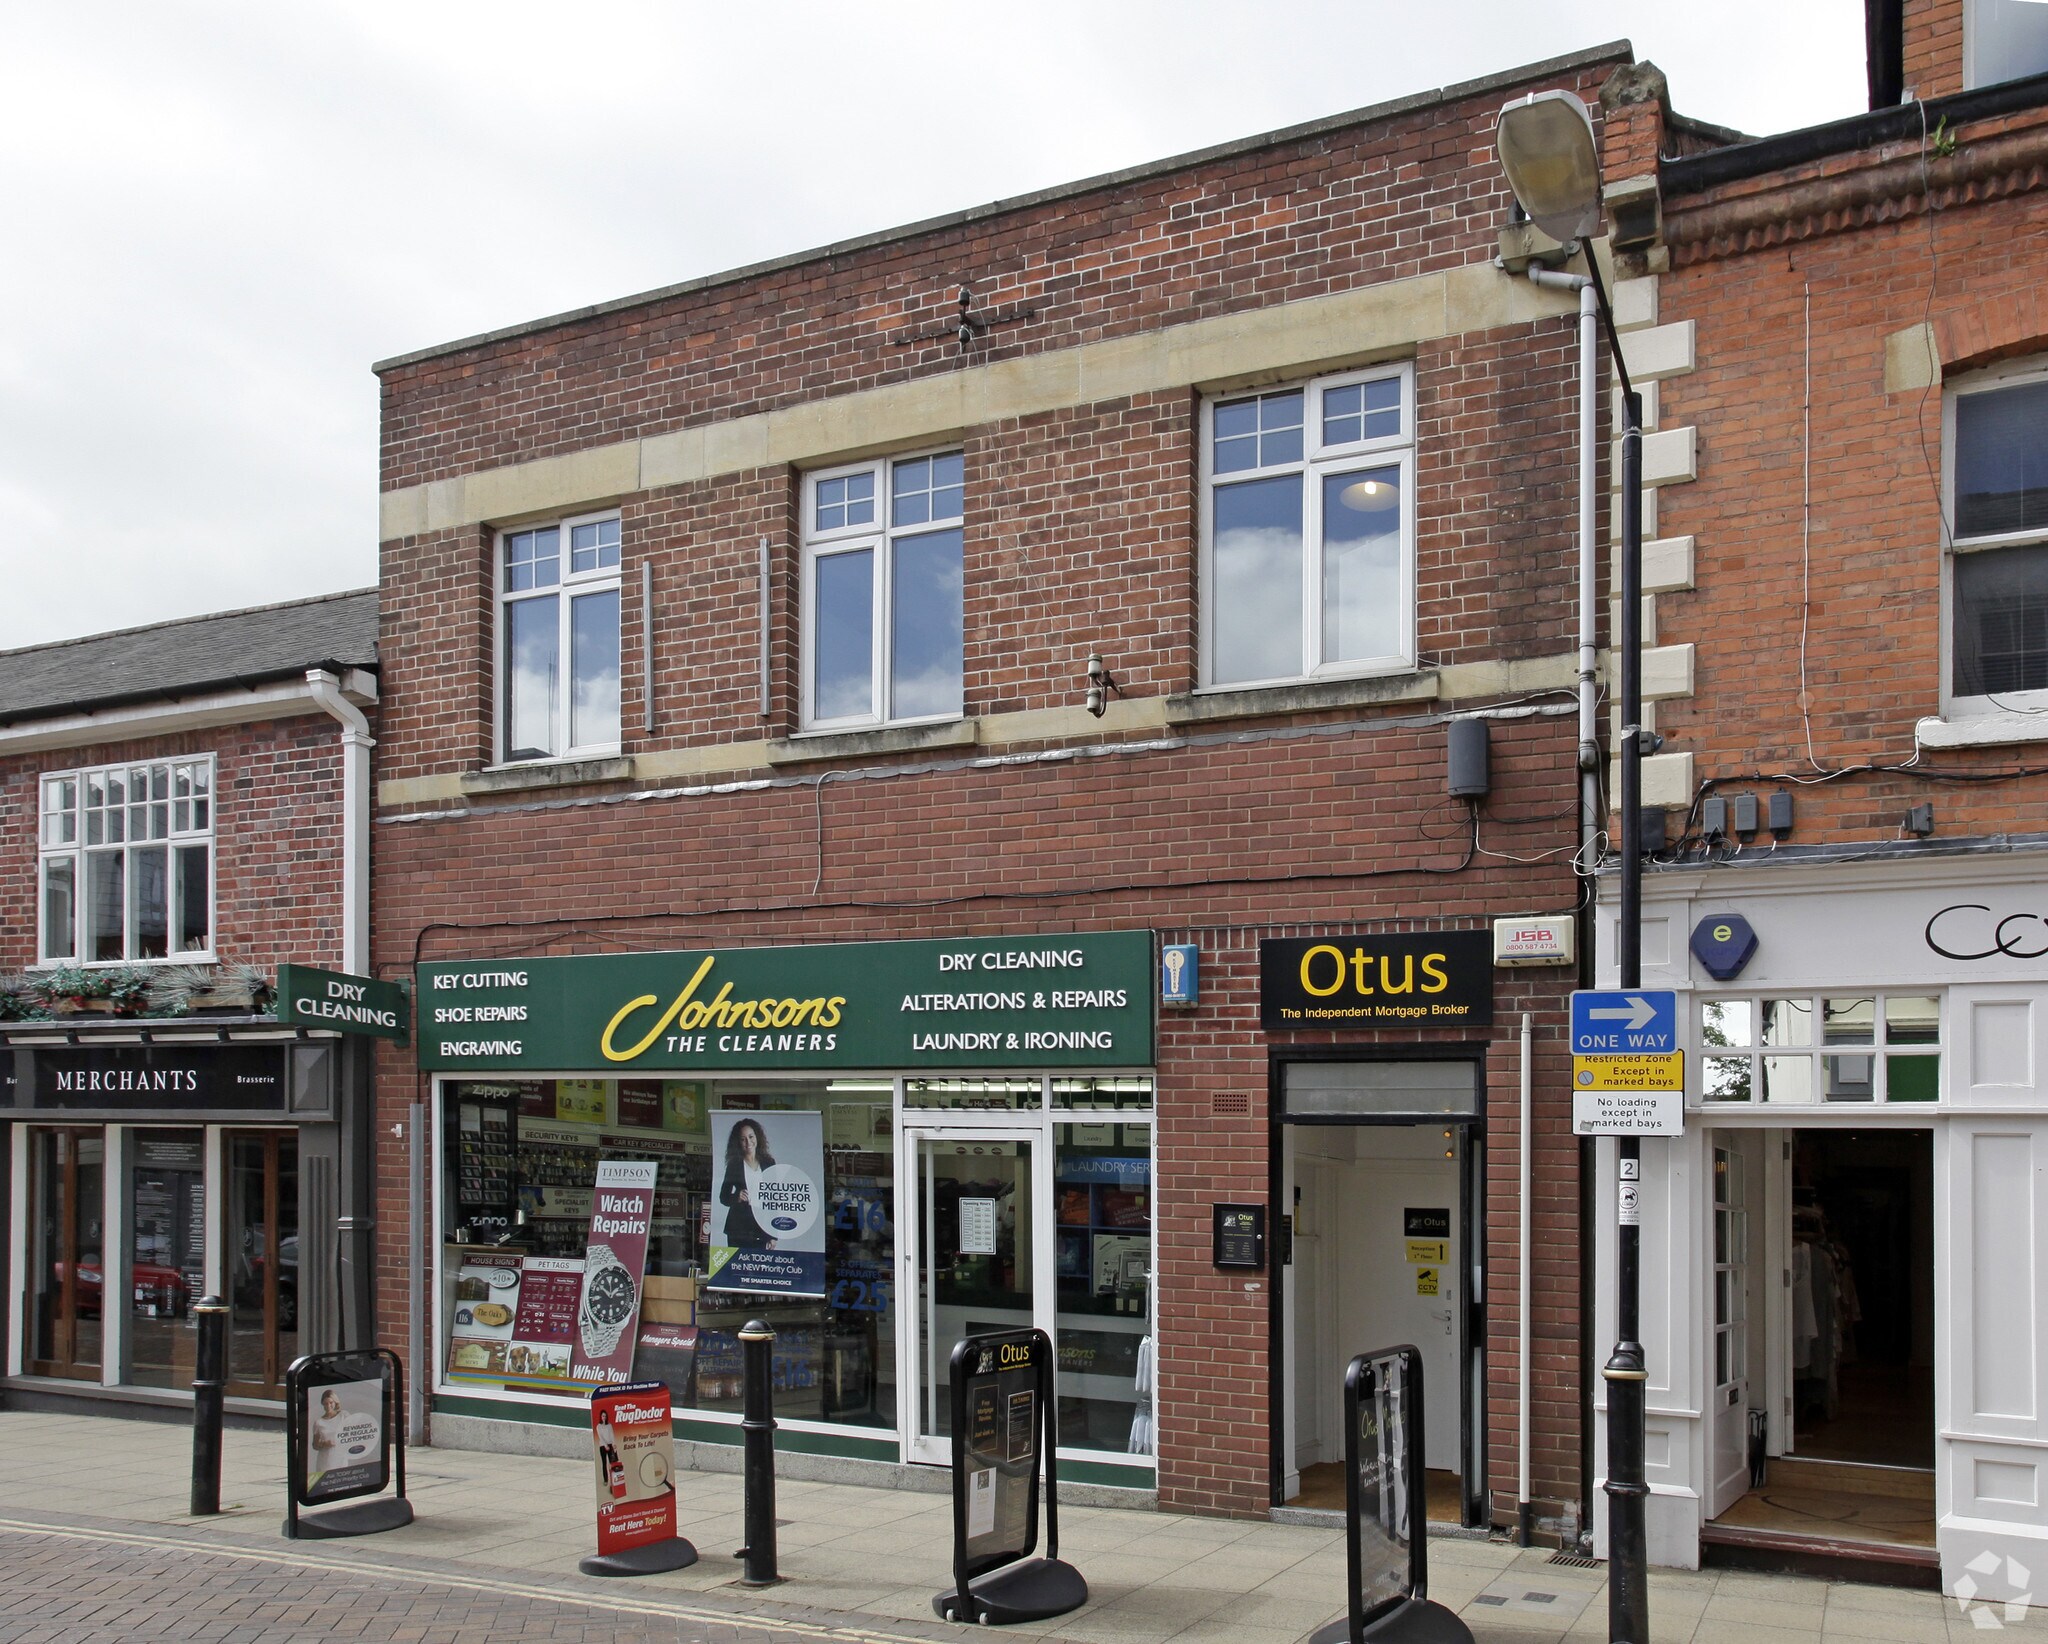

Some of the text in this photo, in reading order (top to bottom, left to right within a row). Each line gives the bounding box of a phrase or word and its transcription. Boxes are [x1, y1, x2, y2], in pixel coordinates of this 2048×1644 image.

[1511, 930, 1552, 942] JSB
[939, 950, 1083, 971] DRY CLEANING
[1300, 945, 1448, 997] Otus
[434, 972, 528, 990] KEY CUTTING
[328, 981, 366, 1002] DRY
[901, 990, 1126, 1011] ALTERATIONS & REPAIRS
[296, 998, 396, 1027] CLEANING
[435, 1006, 527, 1023] SHOE REPAIRS
[601, 956, 846, 1061] Johnsons
[1281, 1004, 1469, 1019] The Independent Mortgage Broker
[667, 1034, 837, 1052] THE CLEANERS
[913, 1031, 1112, 1050] LAUNDRY & IRONING
[1579, 1033, 1668, 1048] ONE WAY
[440, 1041, 522, 1056] ENGRAVING
[1585, 1055, 1672, 1063] Restricted Zone
[1613, 1067, 1664, 1076] Except in
[7, 1077, 18, 1085] Bar
[57, 1070, 197, 1091] MERCHANTS
[237, 1075, 274, 1084] Brasserie
[1649, 1078, 1674, 1087] bays
[1597, 1098, 1657, 1107] No loading
[1601, 1109, 1638, 1118] except
[1592, 1119, 1662, 1129] marked bays
[525, 1131, 579, 1143] SECURITY KEYS
[613, 1138, 627, 1146] CAR
[640, 1141, 674, 1150] SPECIALIST
[602, 1168, 651, 1177] TIMPSON
[1071, 1161, 1151, 1174] LAUNDRY SER
[1624, 1162, 1633, 1175] 2
[759, 1182, 809, 1192] EXCLUSIVE
[758, 1192, 811, 1202] PRICES FOR
[600, 1195, 643, 1214] Watch
[762, 1202, 806, 1212] MEMBERS
[835, 1199, 885, 1232] £16
[1238, 1213, 1253, 1221] Otus
[1424, 1217, 1446, 1226] Otus
[593, 1215, 646, 1237] Repairs
[738, 1253, 795, 1264] Ask TODAY about
[743, 1263, 761, 1271] NEW
[761, 1264, 785, 1275] Priority
[786, 1265, 803, 1274] Club
[836, 1269, 882, 1280] SEPARATES
[832, 1279, 887, 1313] £25
[1001, 1344, 1029, 1363] Otus
[1057, 1347, 1096, 1359] nsons
[573, 1364, 605, 1380] While
[607, 1367, 628, 1383] You
[615, 1406, 665, 1424] RugDoctor
[343, 1423, 372, 1432] REWARDS
[350, 1428, 378, 1437] REGULAR
[340, 1434, 375, 1444] CUSTOMERS
[601, 1504, 613, 1515] TV
[609, 1513, 667, 1534] Rent Here Today!
